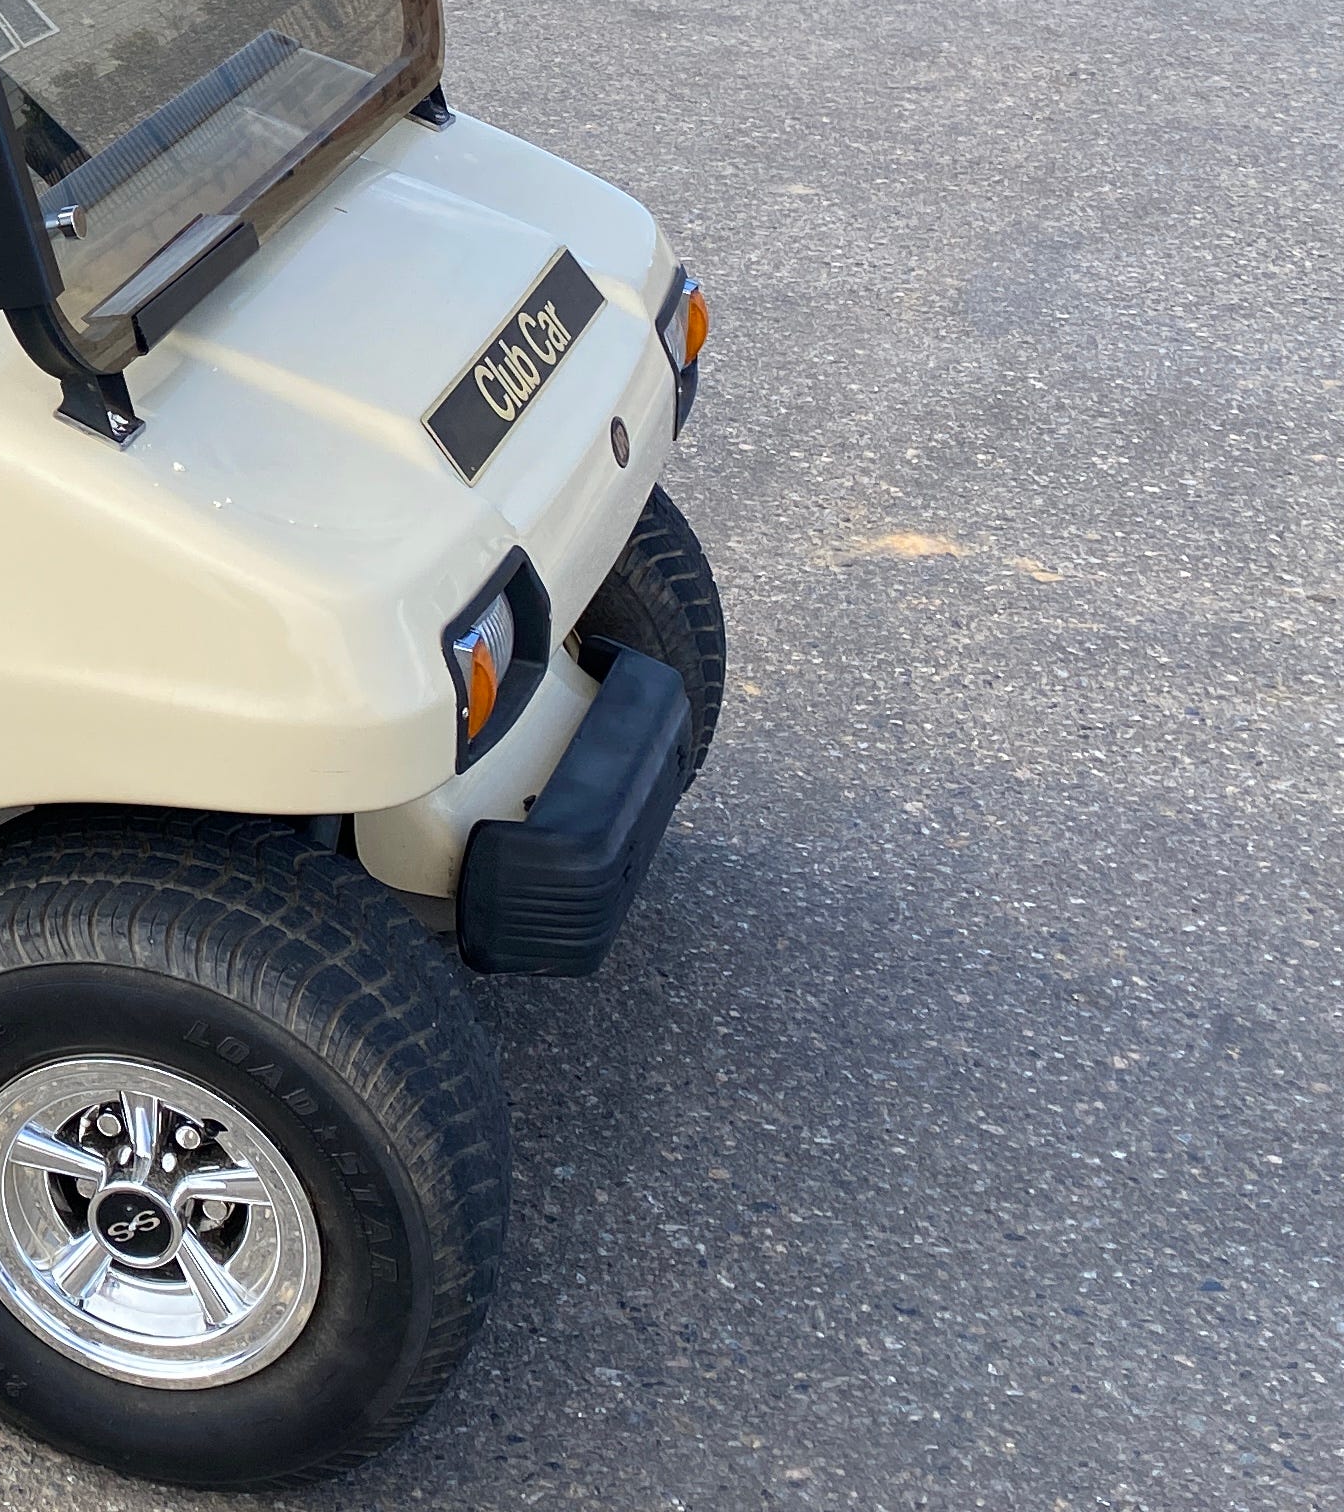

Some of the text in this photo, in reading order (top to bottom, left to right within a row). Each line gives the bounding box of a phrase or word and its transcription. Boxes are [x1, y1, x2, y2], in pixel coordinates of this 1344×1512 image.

[474, 301, 571, 421] Club Car
[107, 1210, 161, 1242] SS
